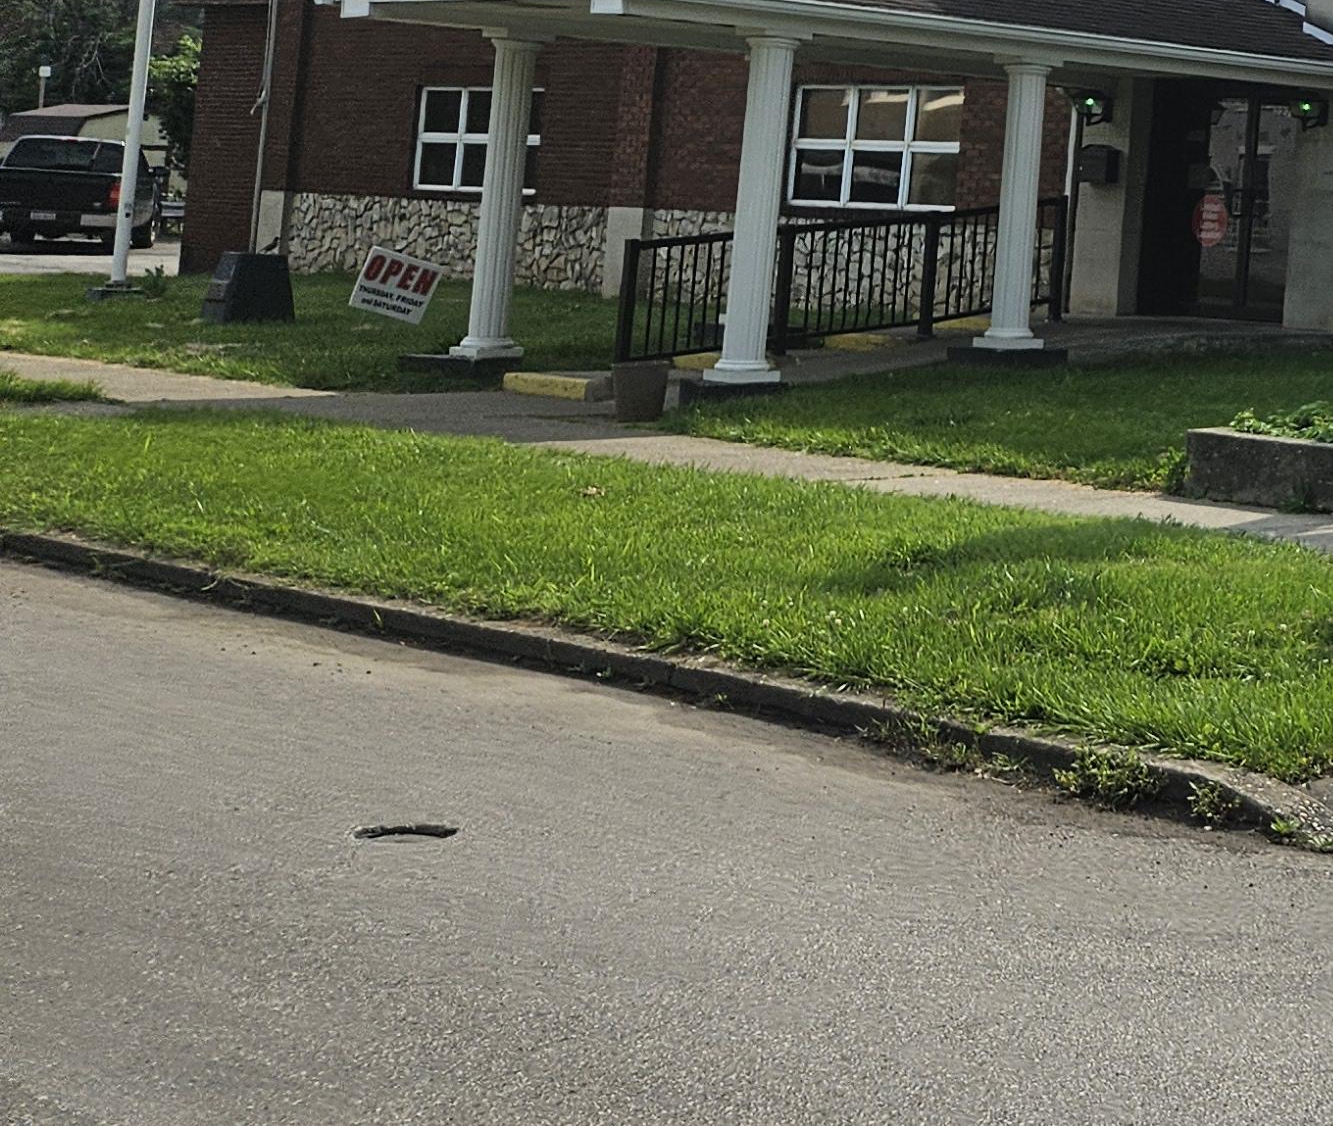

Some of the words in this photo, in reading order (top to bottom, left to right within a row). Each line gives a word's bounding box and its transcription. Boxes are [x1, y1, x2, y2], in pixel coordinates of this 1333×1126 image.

[363, 254, 439, 296] OPEN
[372, 299, 413, 316] SATURDAY
[395, 294, 425, 308] FRIDAY
